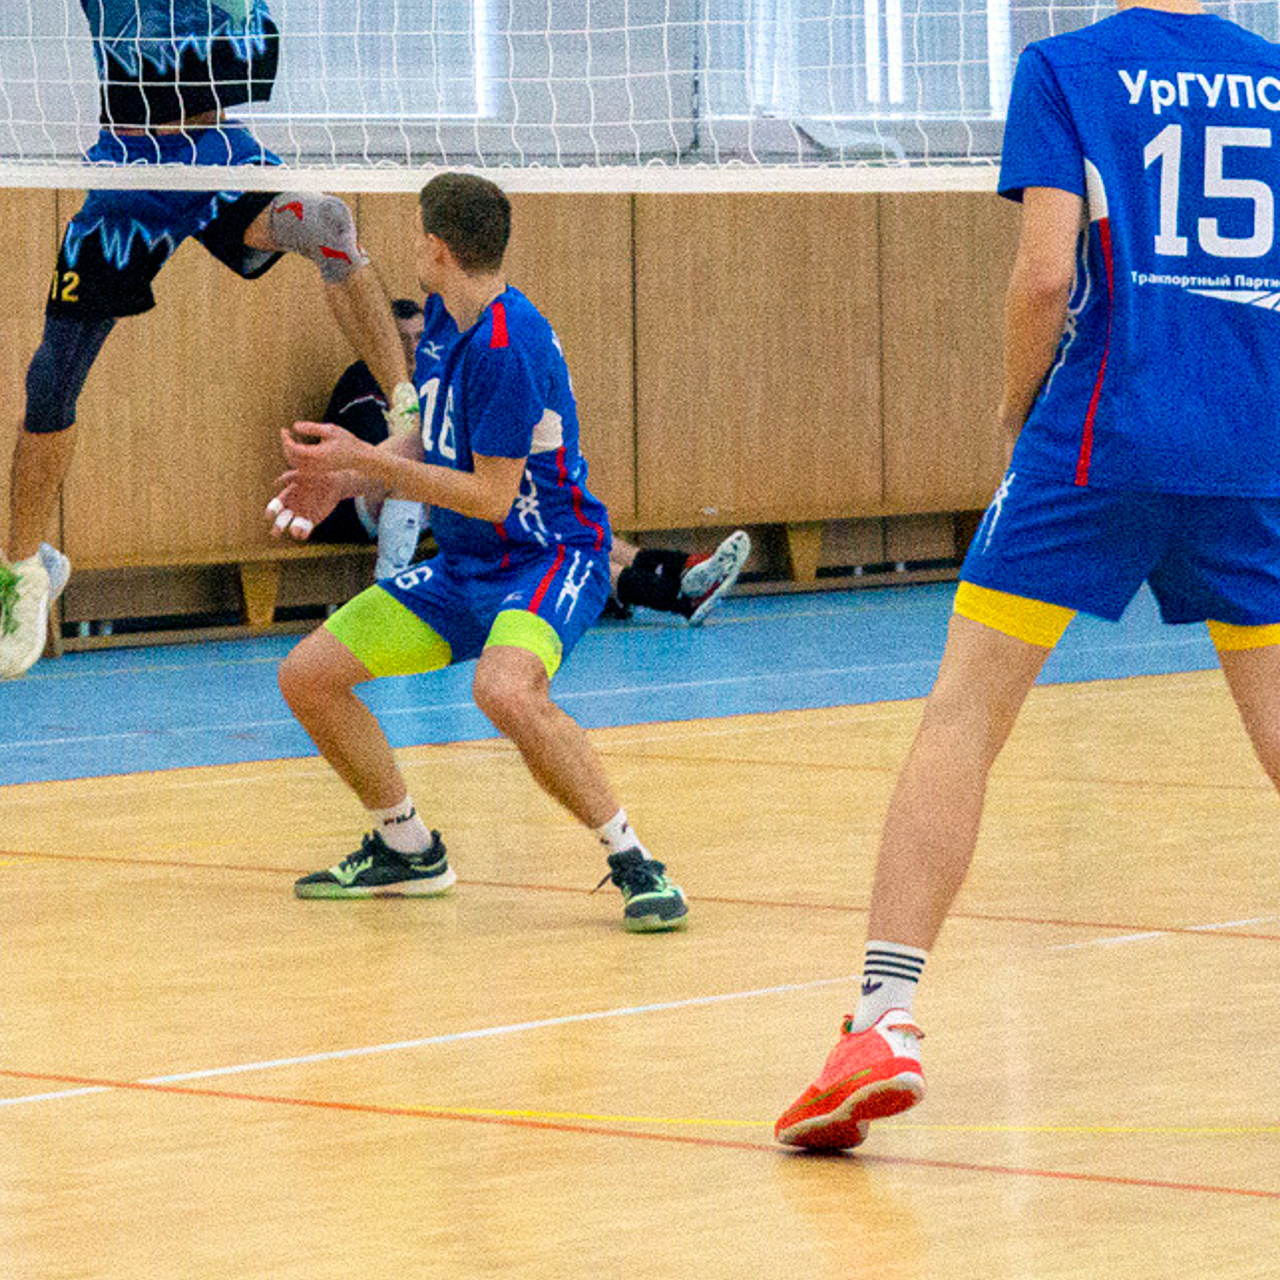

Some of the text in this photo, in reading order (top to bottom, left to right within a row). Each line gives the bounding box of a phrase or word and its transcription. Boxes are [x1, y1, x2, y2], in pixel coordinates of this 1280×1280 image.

[1118, 70, 1280, 114] УрГУПС
[1143, 123, 1275, 258] 15
[1234, 274, 1280, 290] Партн
[419, 377, 457, 460] 16
